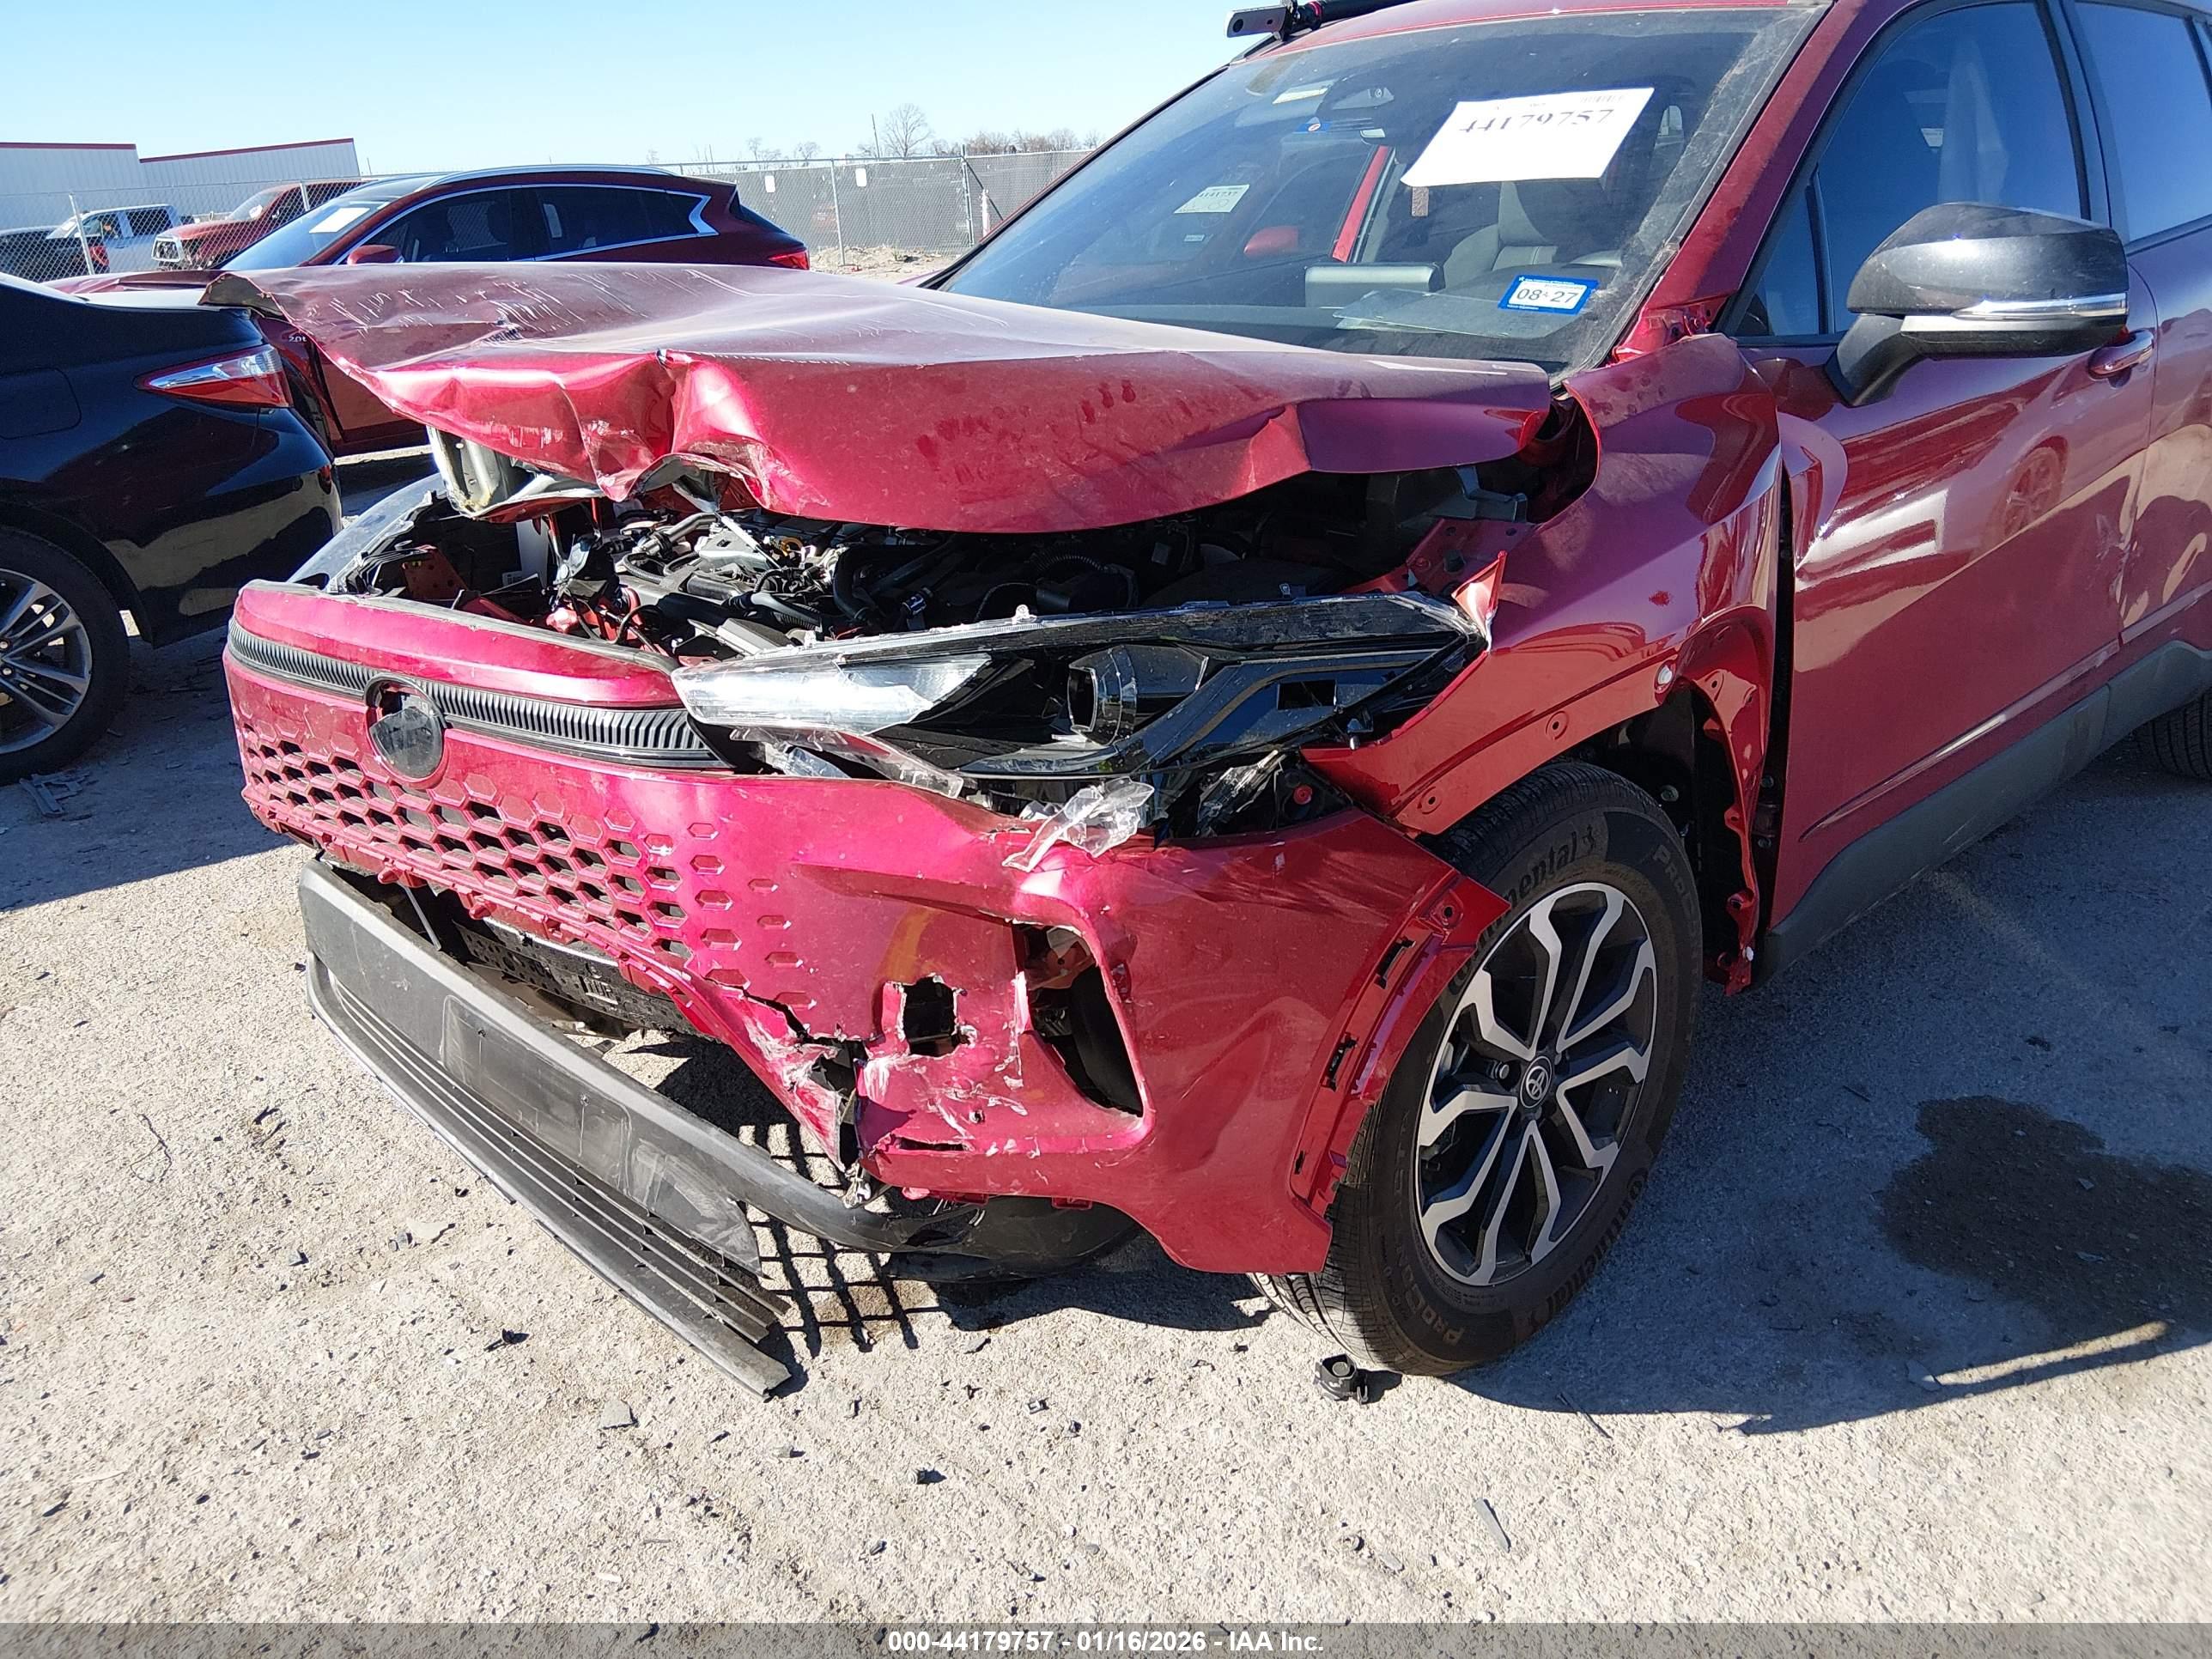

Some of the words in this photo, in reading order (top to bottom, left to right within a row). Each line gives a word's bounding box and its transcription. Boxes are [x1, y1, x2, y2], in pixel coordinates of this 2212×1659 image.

[1459, 108, 1614, 133] 44179757
[1516, 288, 1542, 301] 08
[1550, 290, 1579, 303] 27
